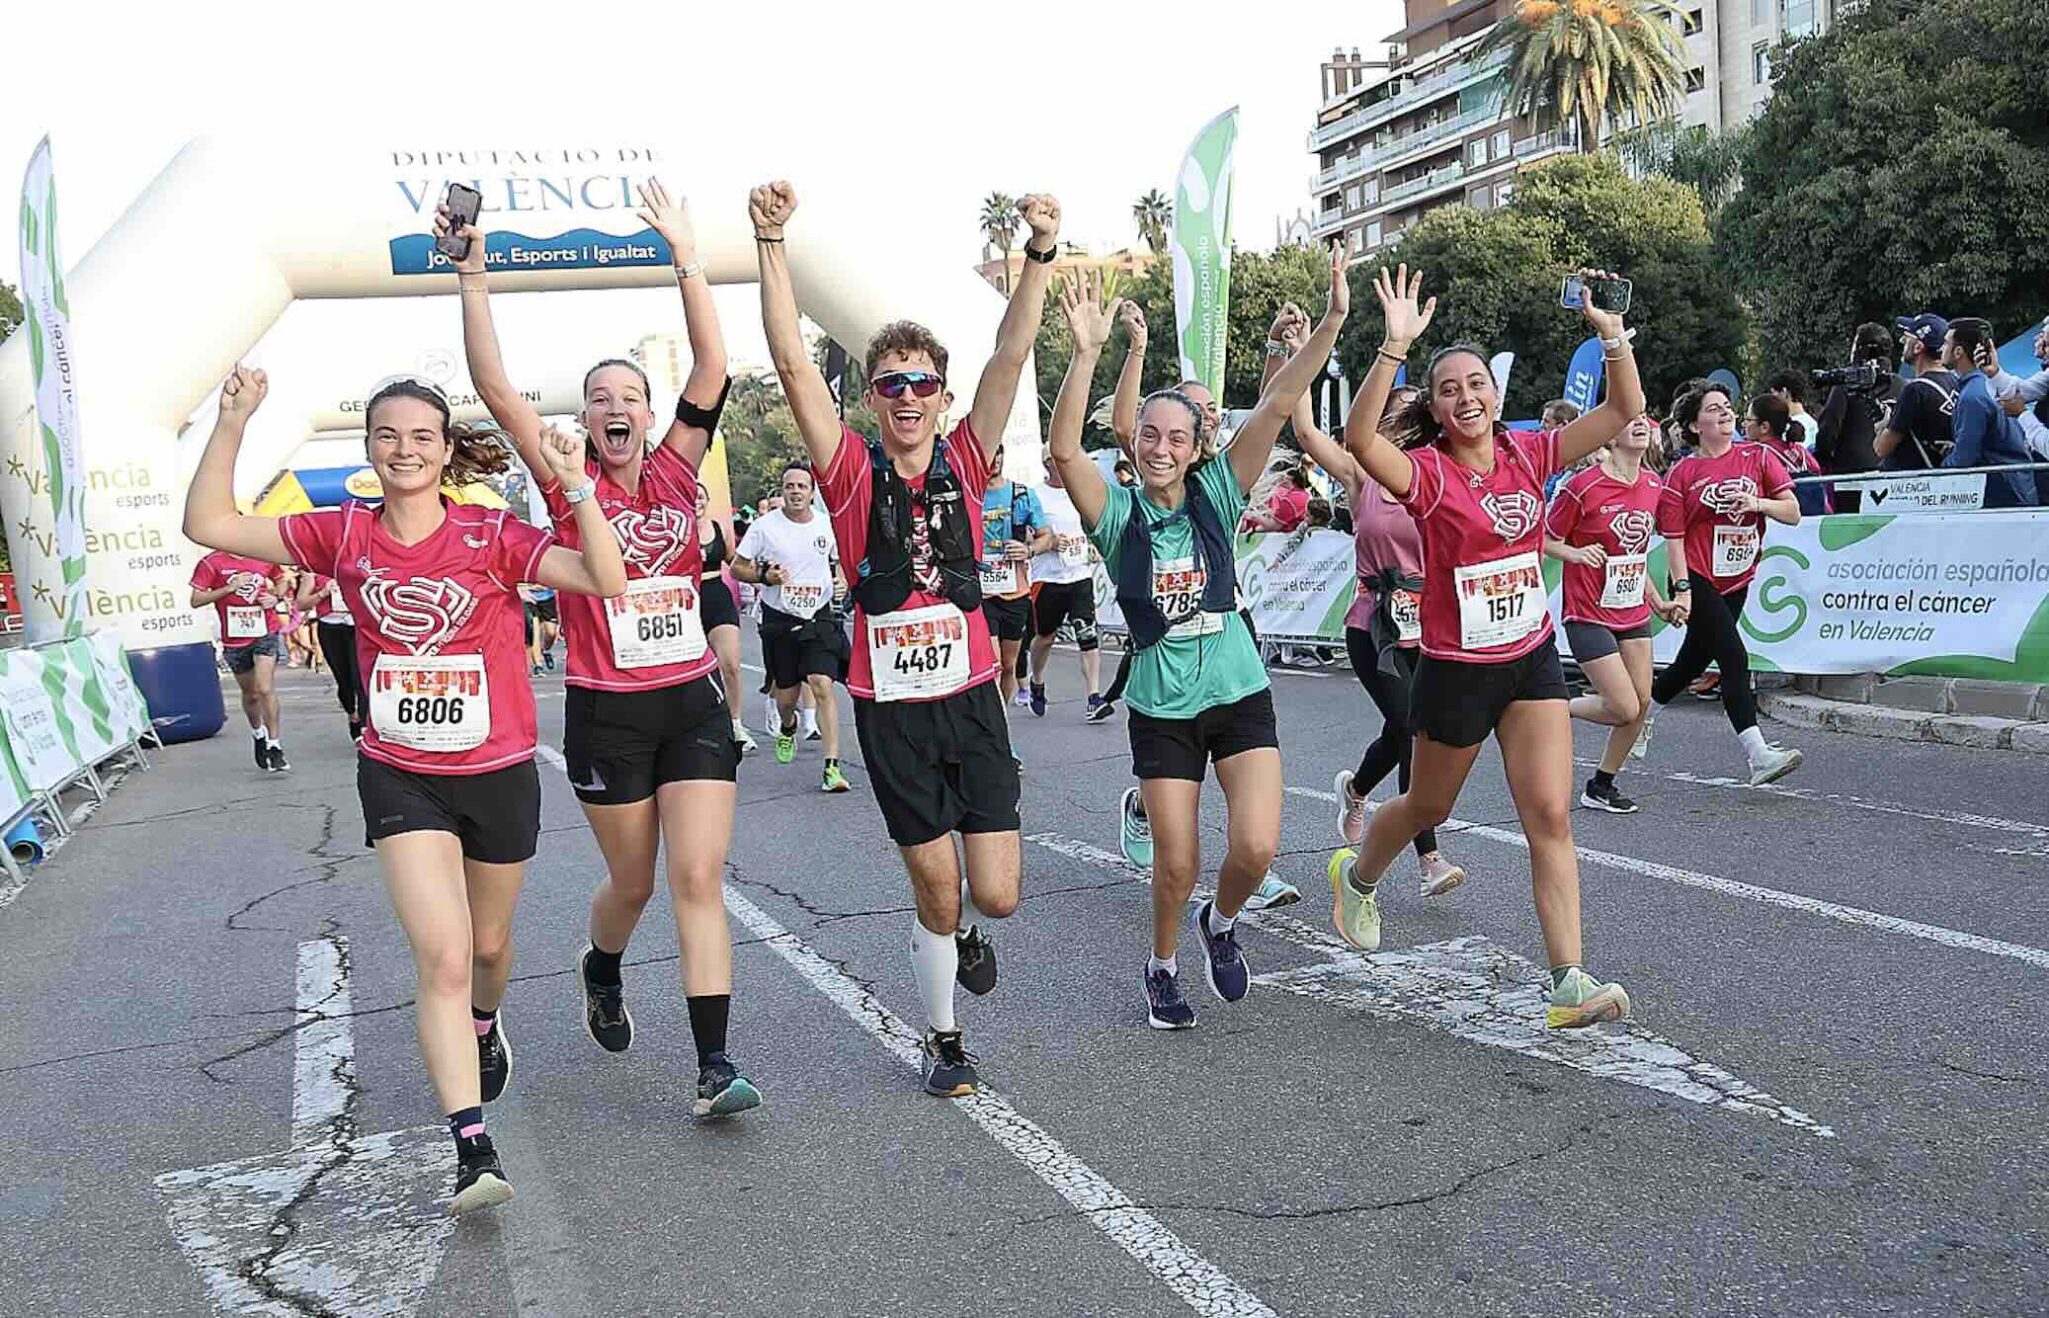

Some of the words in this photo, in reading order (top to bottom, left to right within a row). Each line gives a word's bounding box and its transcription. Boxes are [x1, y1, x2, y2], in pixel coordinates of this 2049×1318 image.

[395, 170, 668, 214] VLÈNCI
[426, 249, 508, 270] Jovut,
[511, 246, 577, 264] Esports
[583, 244, 588, 260] i
[593, 244, 656, 261] Igualtat
[116, 492, 171, 509] esports
[1921, 494, 1938, 506] DEL
[128, 552, 182, 572] esports
[1827, 558, 1939, 581] asociación
[1944, 557, 2049, 587] española
[50, 585, 176, 619] Vlència
[1487, 592, 1524, 622] 1517
[1822, 590, 1889, 611] contra
[1894, 590, 1914, 612] el
[1918, 590, 1996, 614] cáncer
[141, 613, 193, 632] esports
[637, 613, 683, 641] 6851
[1819, 623, 1844, 639] en
[1850, 619, 1935, 641] Valencia
[894, 643, 952, 675] 4487
[398, 697, 464, 724] 6806
